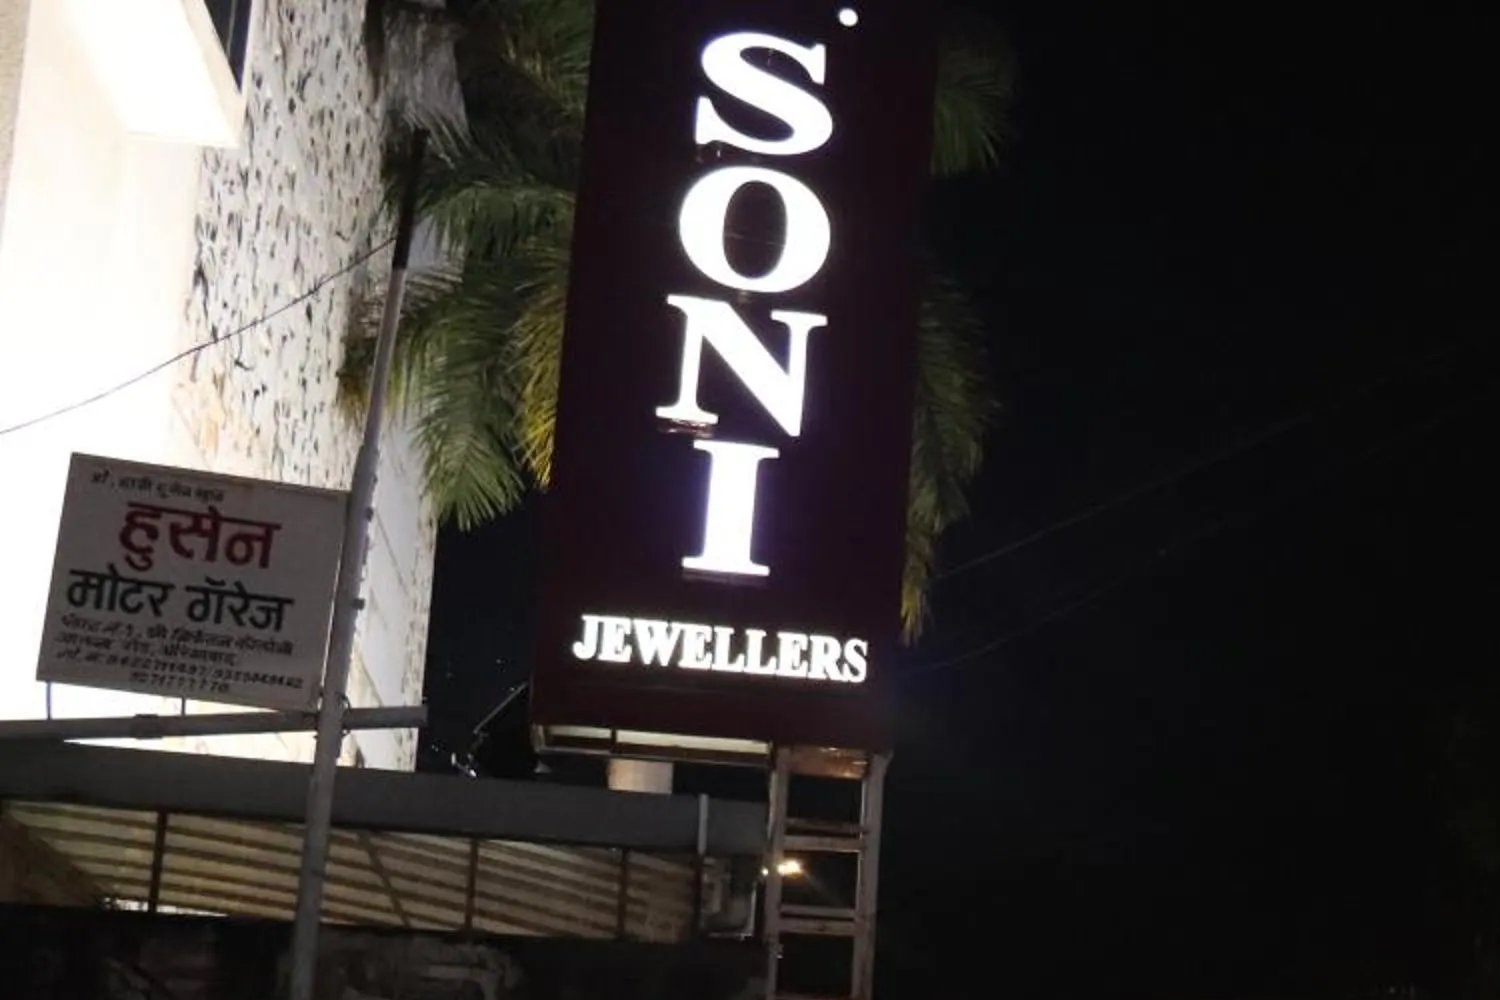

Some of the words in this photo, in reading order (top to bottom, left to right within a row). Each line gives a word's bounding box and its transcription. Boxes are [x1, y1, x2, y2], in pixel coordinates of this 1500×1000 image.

[656, 32, 834, 577] SONI
[119, 501, 282, 571] हुसेन
[67, 563, 175, 617] मोटर
[572, 614, 868, 684] JEWELLERS
